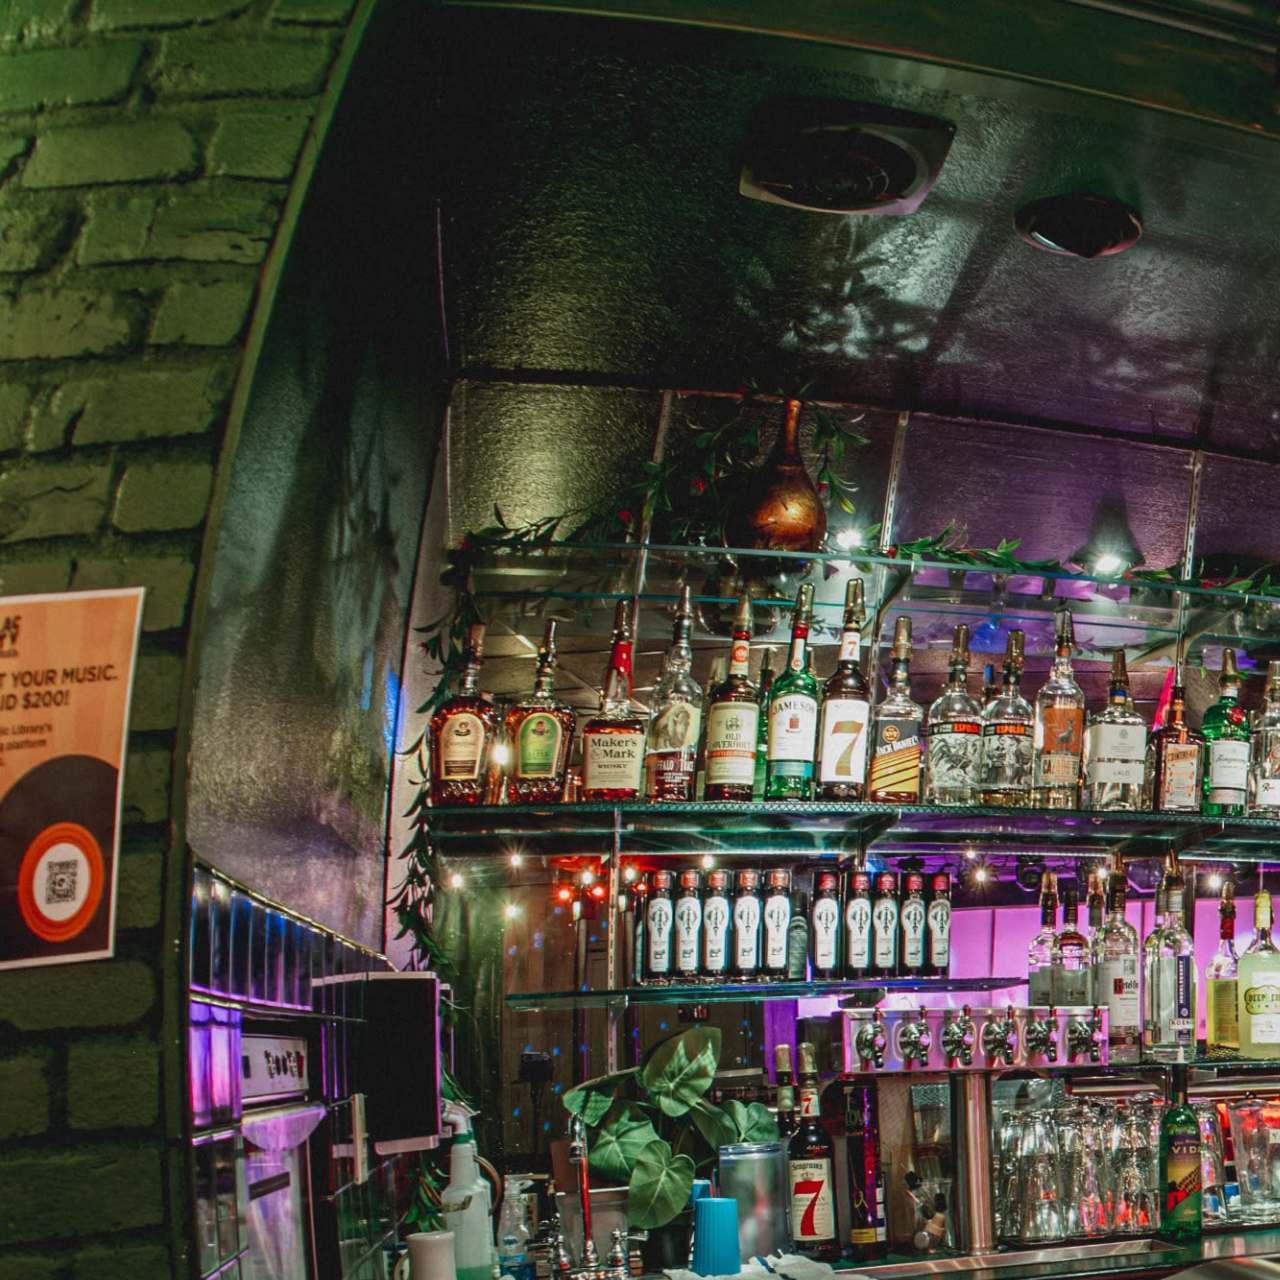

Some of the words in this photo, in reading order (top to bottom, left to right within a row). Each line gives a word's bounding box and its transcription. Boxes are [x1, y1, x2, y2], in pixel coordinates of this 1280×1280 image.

[12, 669, 57, 687] YOUR
[61, 664, 117, 683] MUSIC.
[22, 690, 70, 710] $200!
[591, 737, 637, 748] Maker's
[831, 720, 864, 776] 7
[603, 749, 635, 759] Mark
[801, 1097, 812, 1114] 7
[793, 1180, 824, 1236] 7
